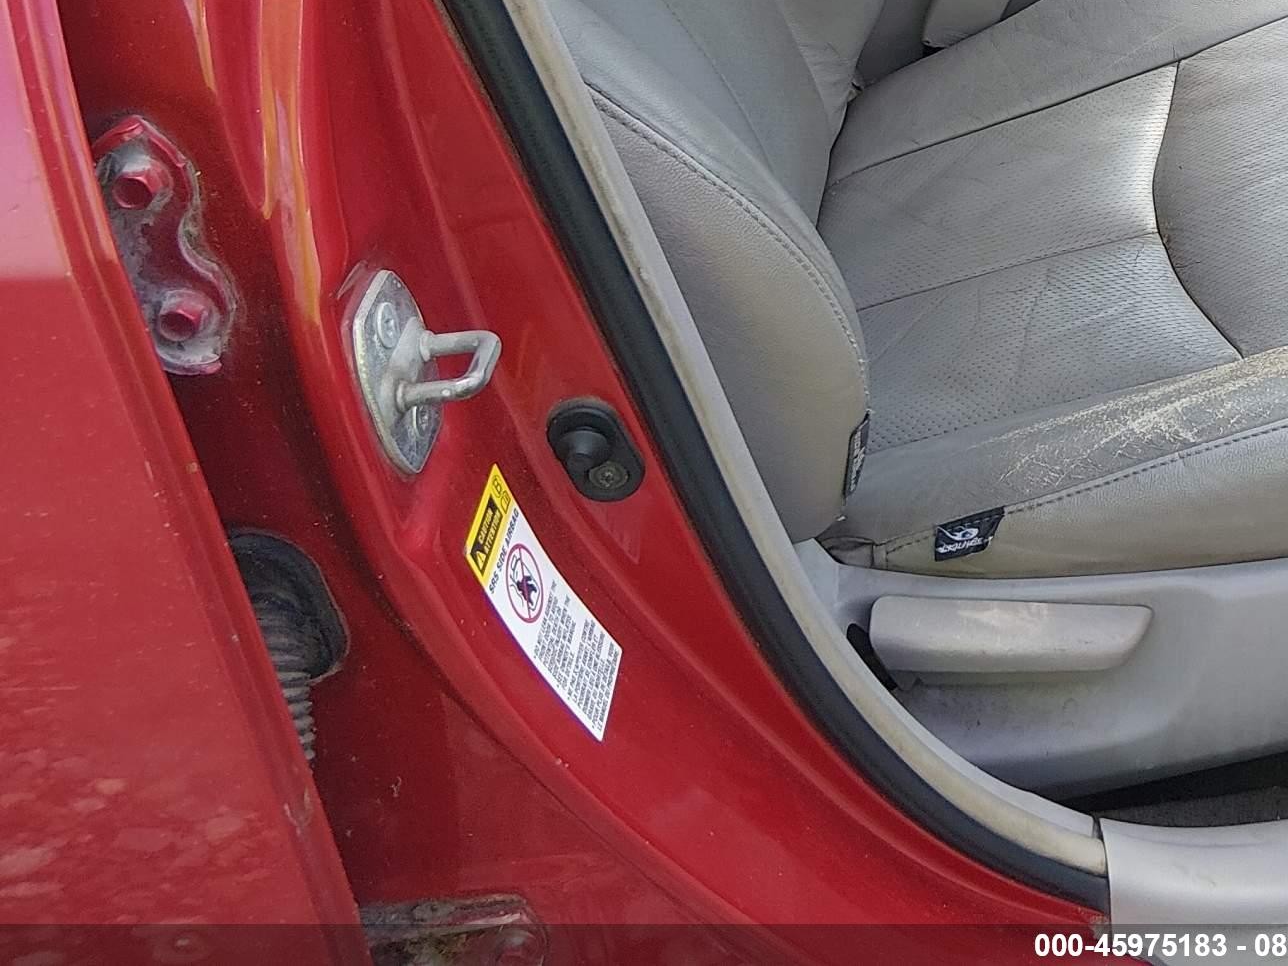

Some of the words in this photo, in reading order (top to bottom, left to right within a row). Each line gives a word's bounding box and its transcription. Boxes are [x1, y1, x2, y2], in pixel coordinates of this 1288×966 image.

[477, 504, 493, 547] CAUTION
[482, 505, 501, 556] ATTENTION
[487, 567, 499, 596] SRS
[495, 542, 507, 573] SIDE
[503, 505, 520, 548] AIRBAG
